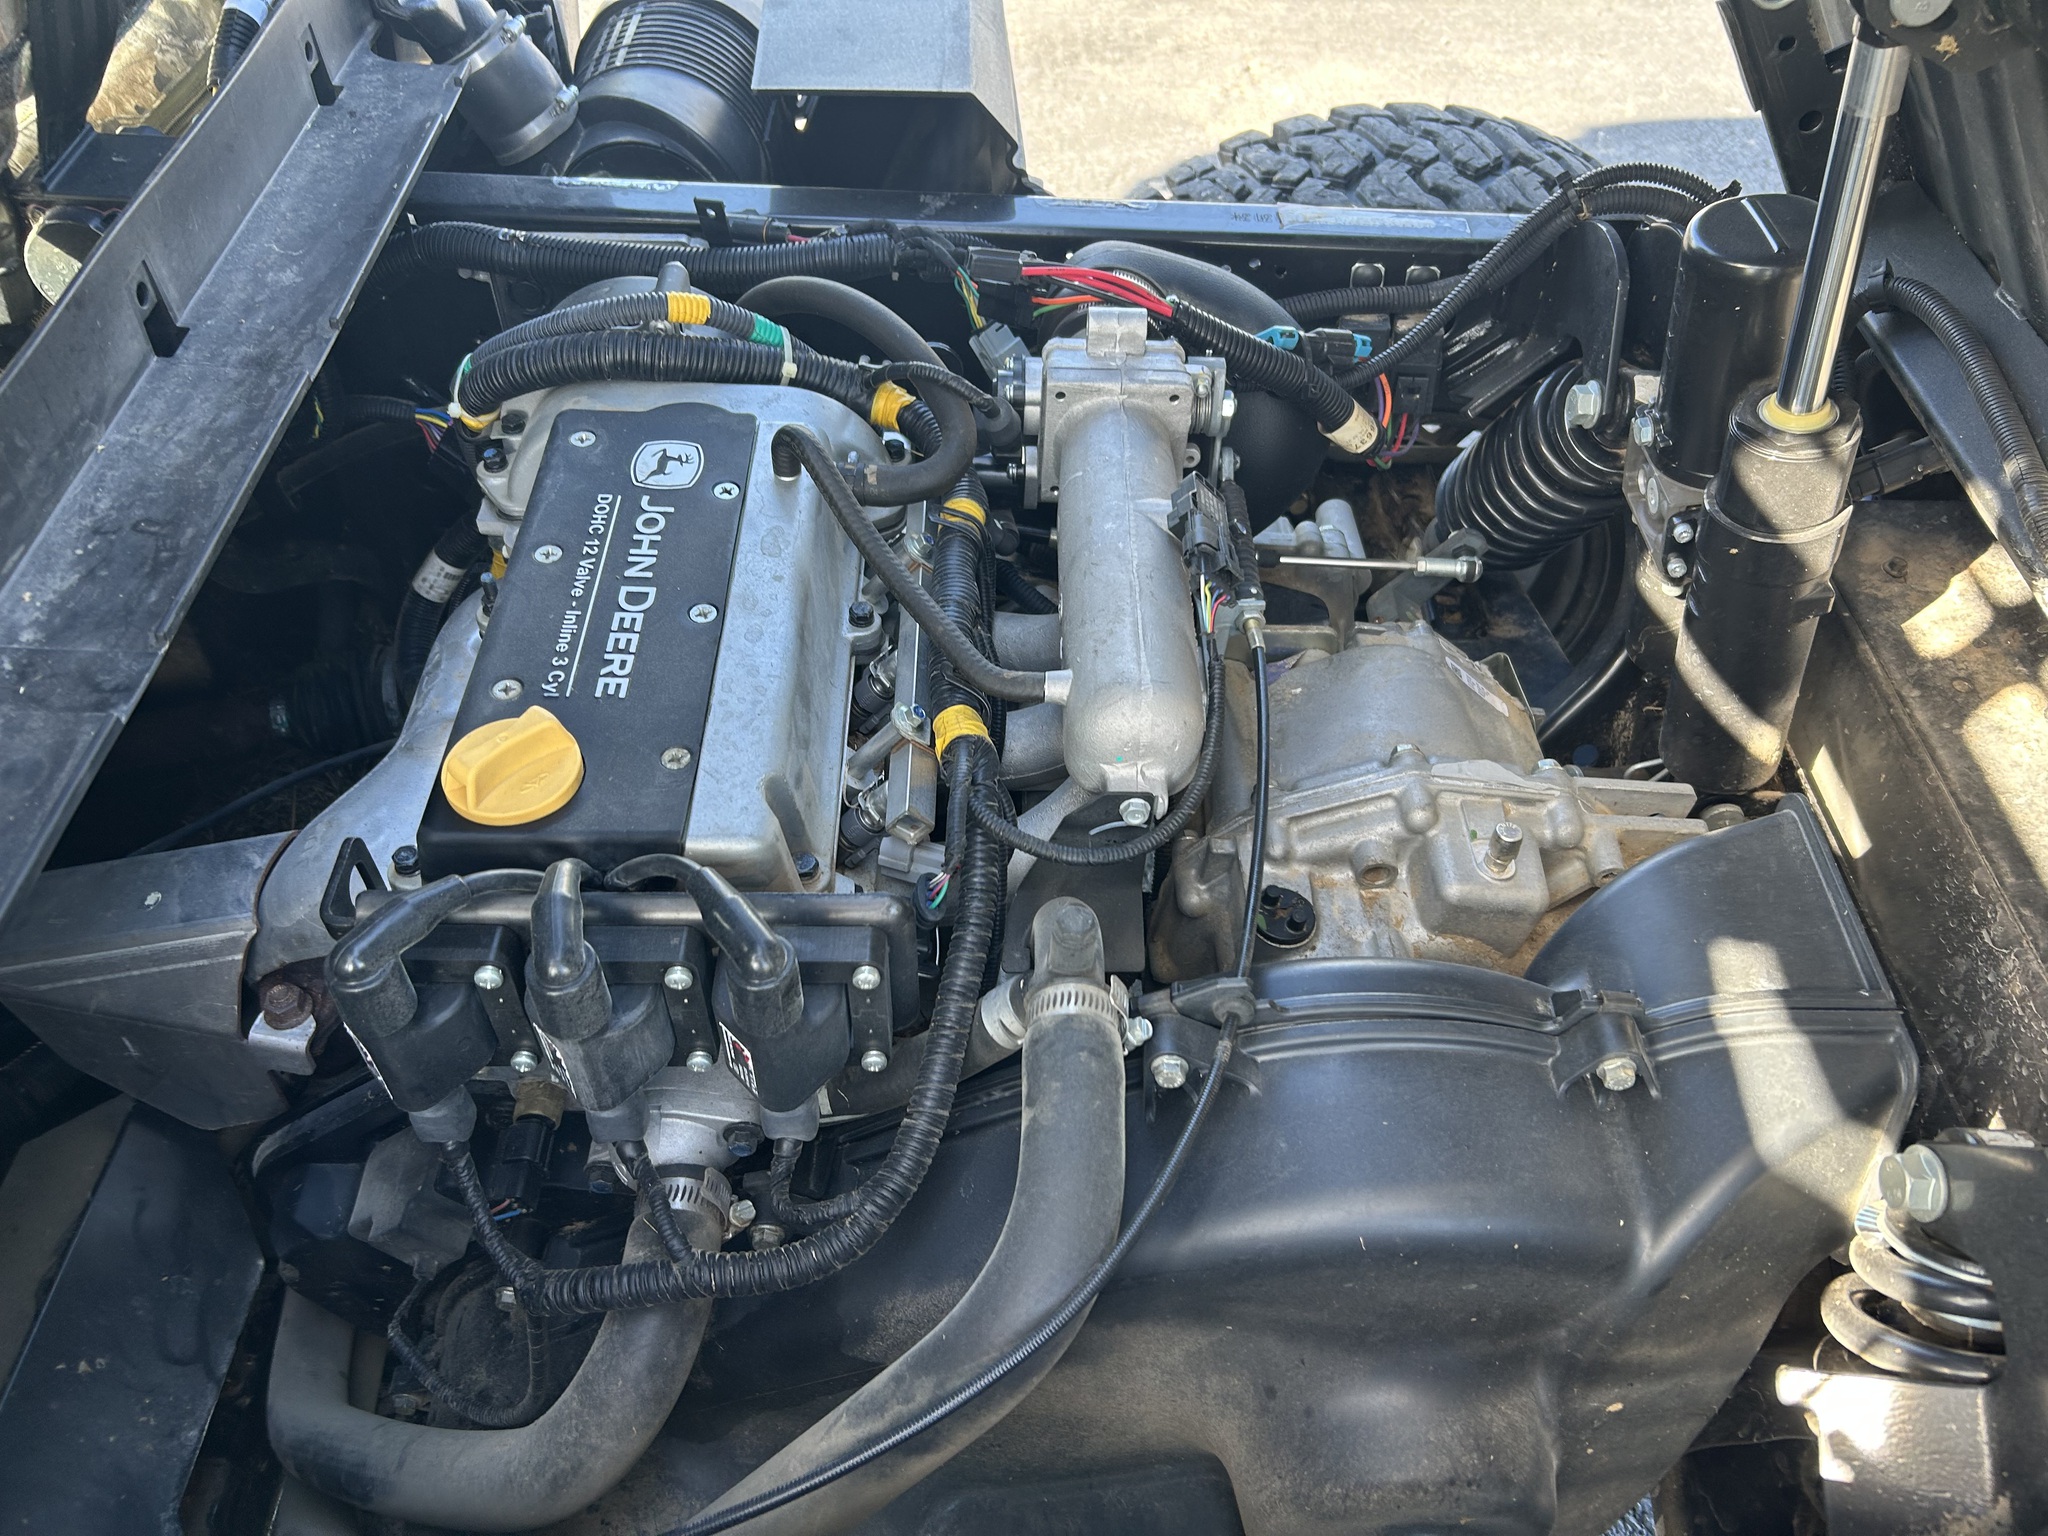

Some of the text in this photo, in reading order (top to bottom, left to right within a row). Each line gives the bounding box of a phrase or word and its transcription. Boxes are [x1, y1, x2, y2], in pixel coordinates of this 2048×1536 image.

[588, 493, 613, 535] DOHC
[582, 538, 600, 555] 12
[571, 558, 596, 598] Valve
[594, 495, 674, 699] JOHN DEERE
[555, 610, 582, 653] Inline
[552, 656, 569, 666] 3
[541, 670, 565, 697] Cyl
